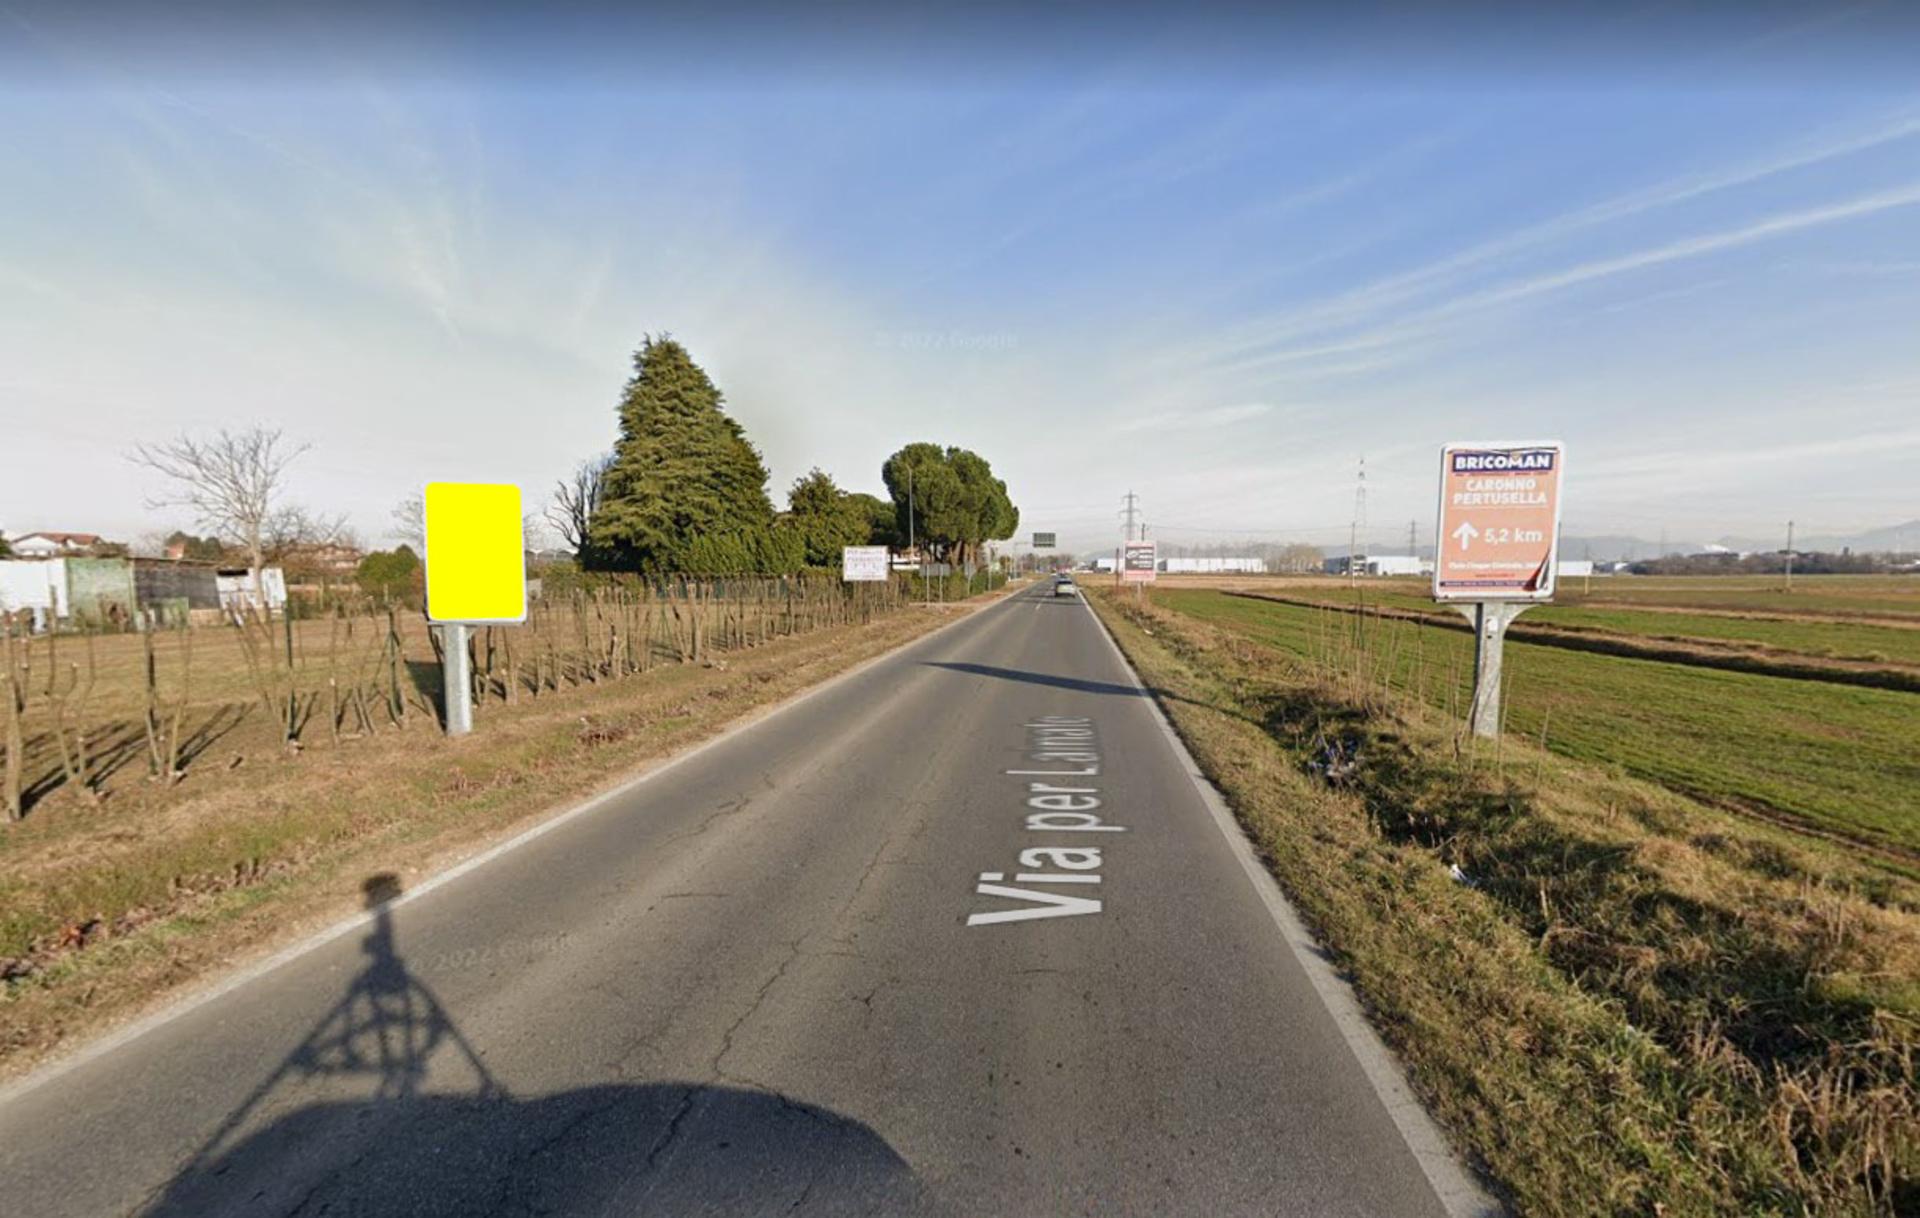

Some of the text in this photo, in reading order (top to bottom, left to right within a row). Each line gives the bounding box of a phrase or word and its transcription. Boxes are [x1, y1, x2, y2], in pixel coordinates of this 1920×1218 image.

[1455, 454, 1549, 469] BRICOMAN
[1466, 478, 1536, 491] CARONNO
[1453, 492, 1547, 504] PERTUSELLA
[1485, 527, 1543, 545] 5,2 km
